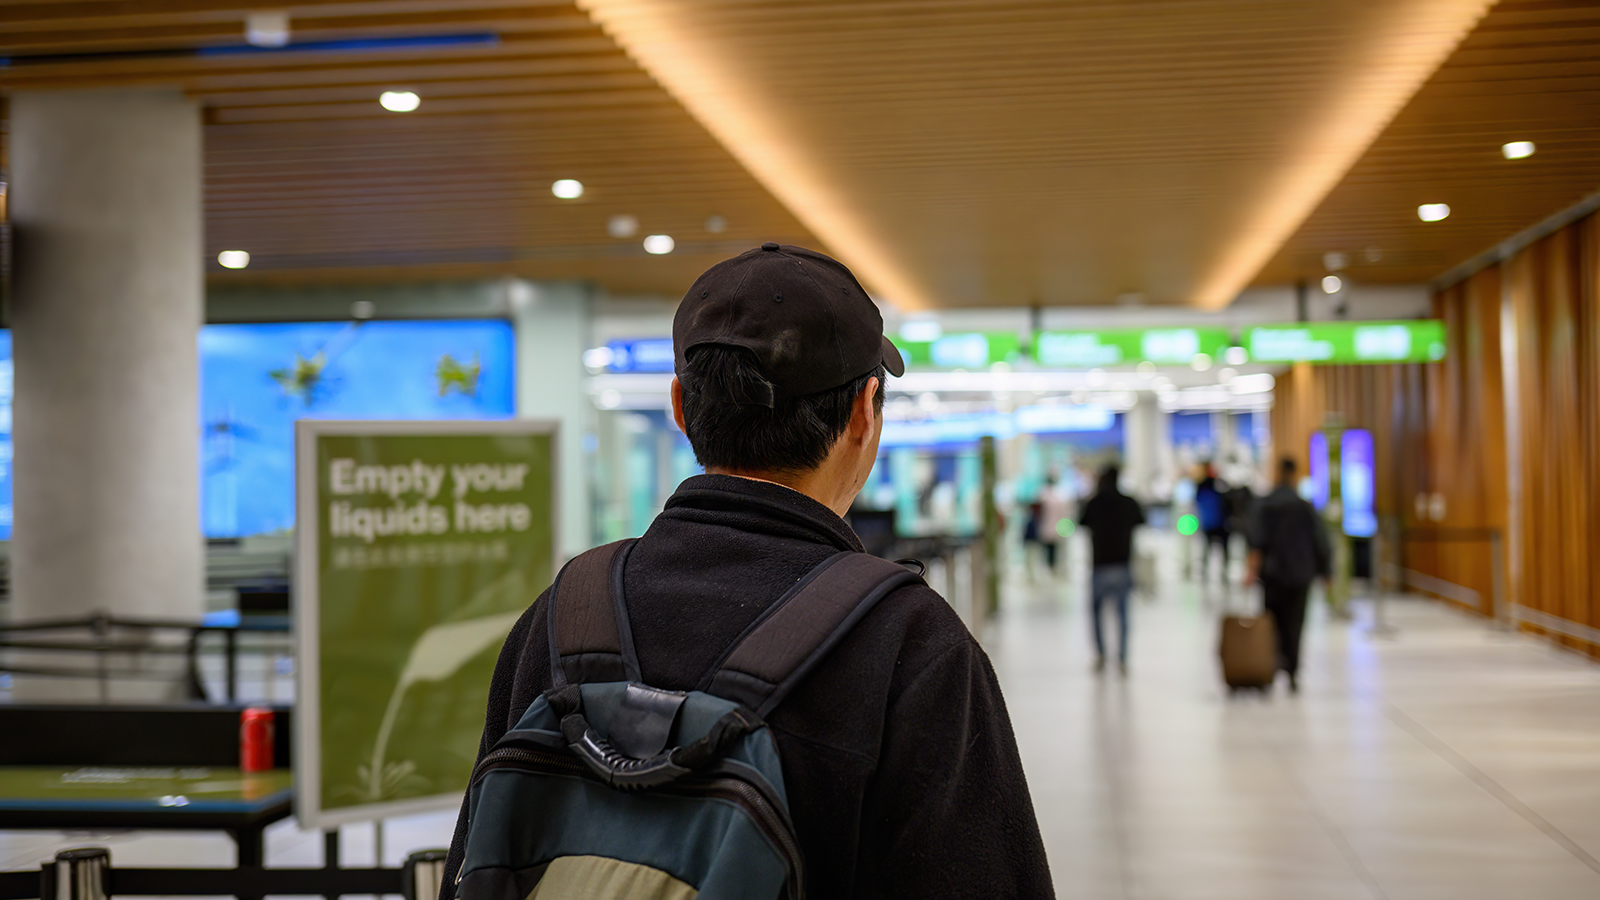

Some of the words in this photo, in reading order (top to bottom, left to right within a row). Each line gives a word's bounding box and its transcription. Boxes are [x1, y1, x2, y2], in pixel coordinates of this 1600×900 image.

[330, 458, 445, 498] Empty
[452, 463, 529, 498] your
[330, 500, 448, 542] liquids
[455, 501, 531, 533] here
